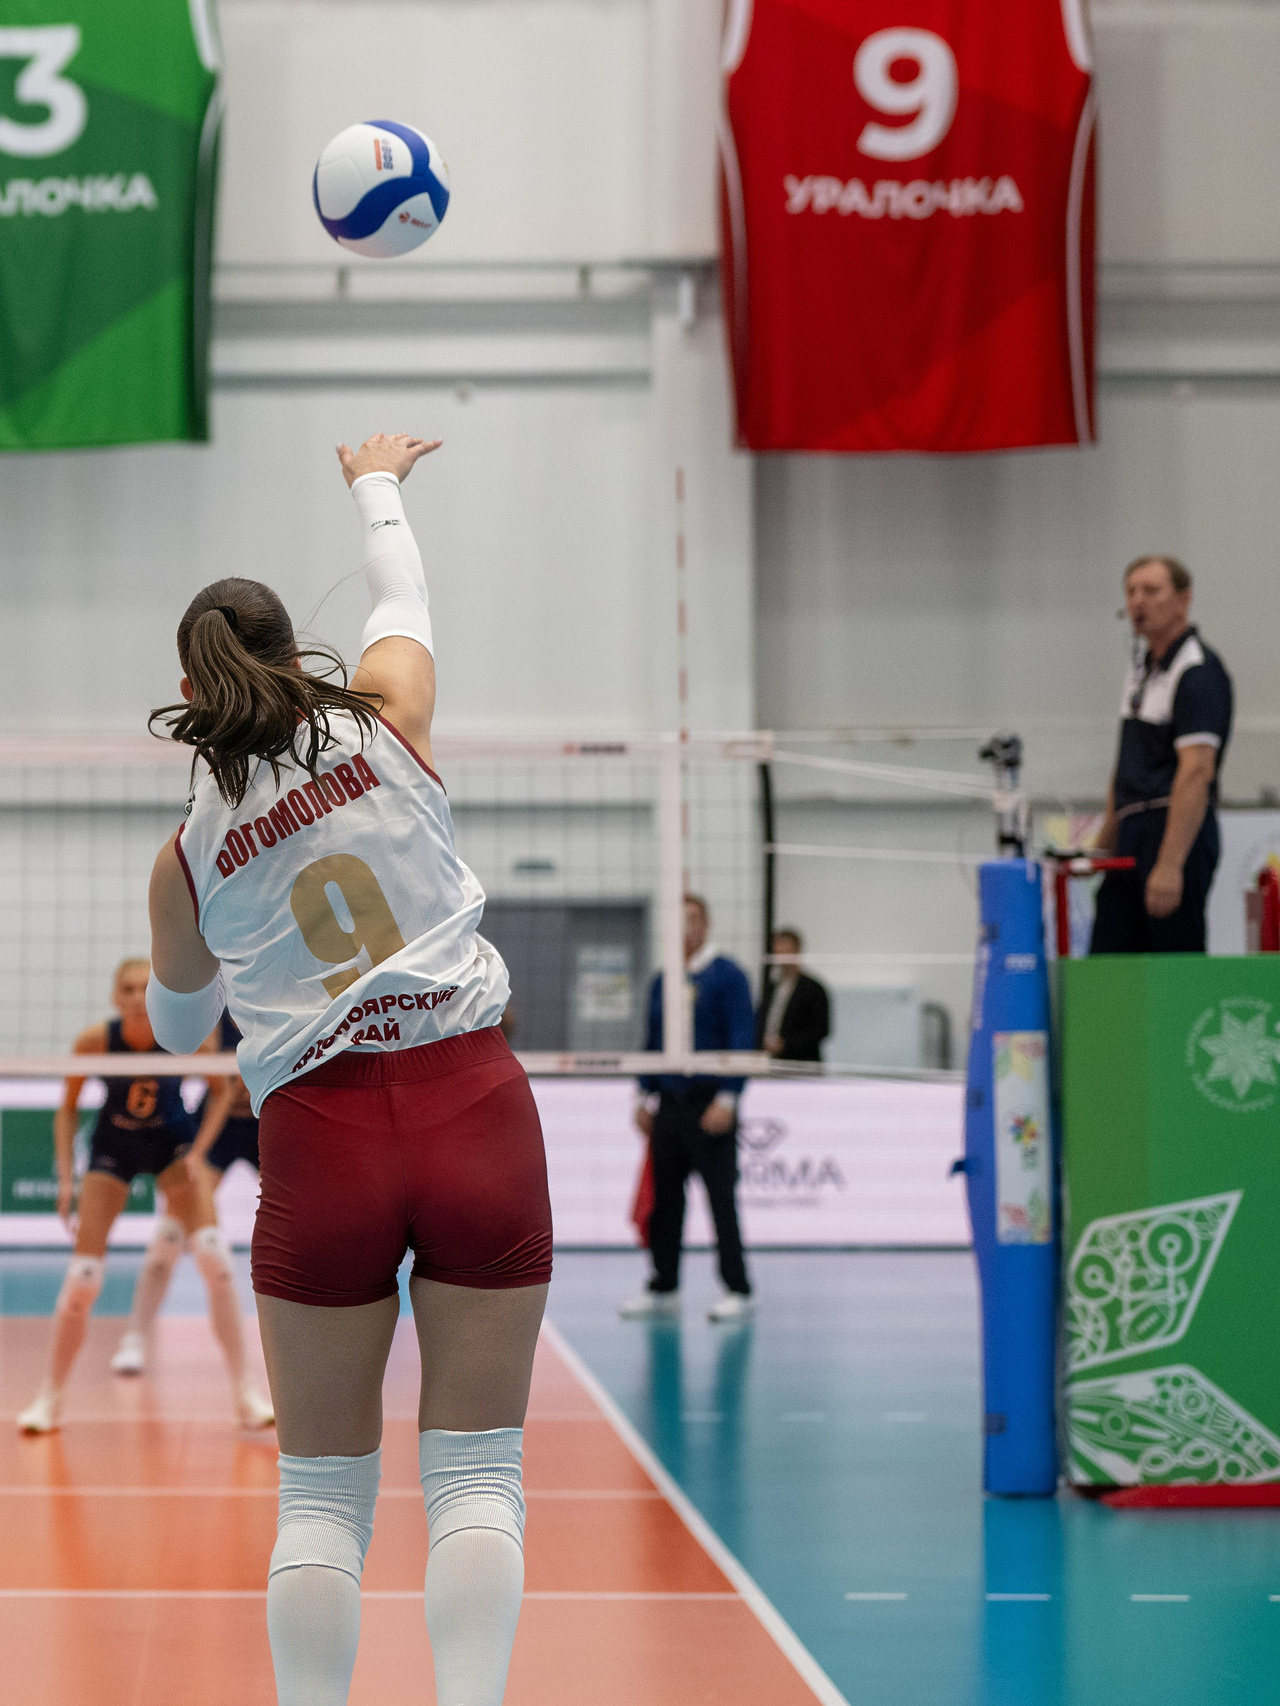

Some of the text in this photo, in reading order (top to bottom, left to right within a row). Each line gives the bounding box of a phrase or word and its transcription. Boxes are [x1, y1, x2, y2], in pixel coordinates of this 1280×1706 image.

[853, 26, 959, 162] 9
[783, 174, 1024, 219] УРАЛОЧКА
[290, 853, 406, 1000] 9
[351, 1018, 401, 1045] РАЙ
[126, 1080, 159, 1119] 6
